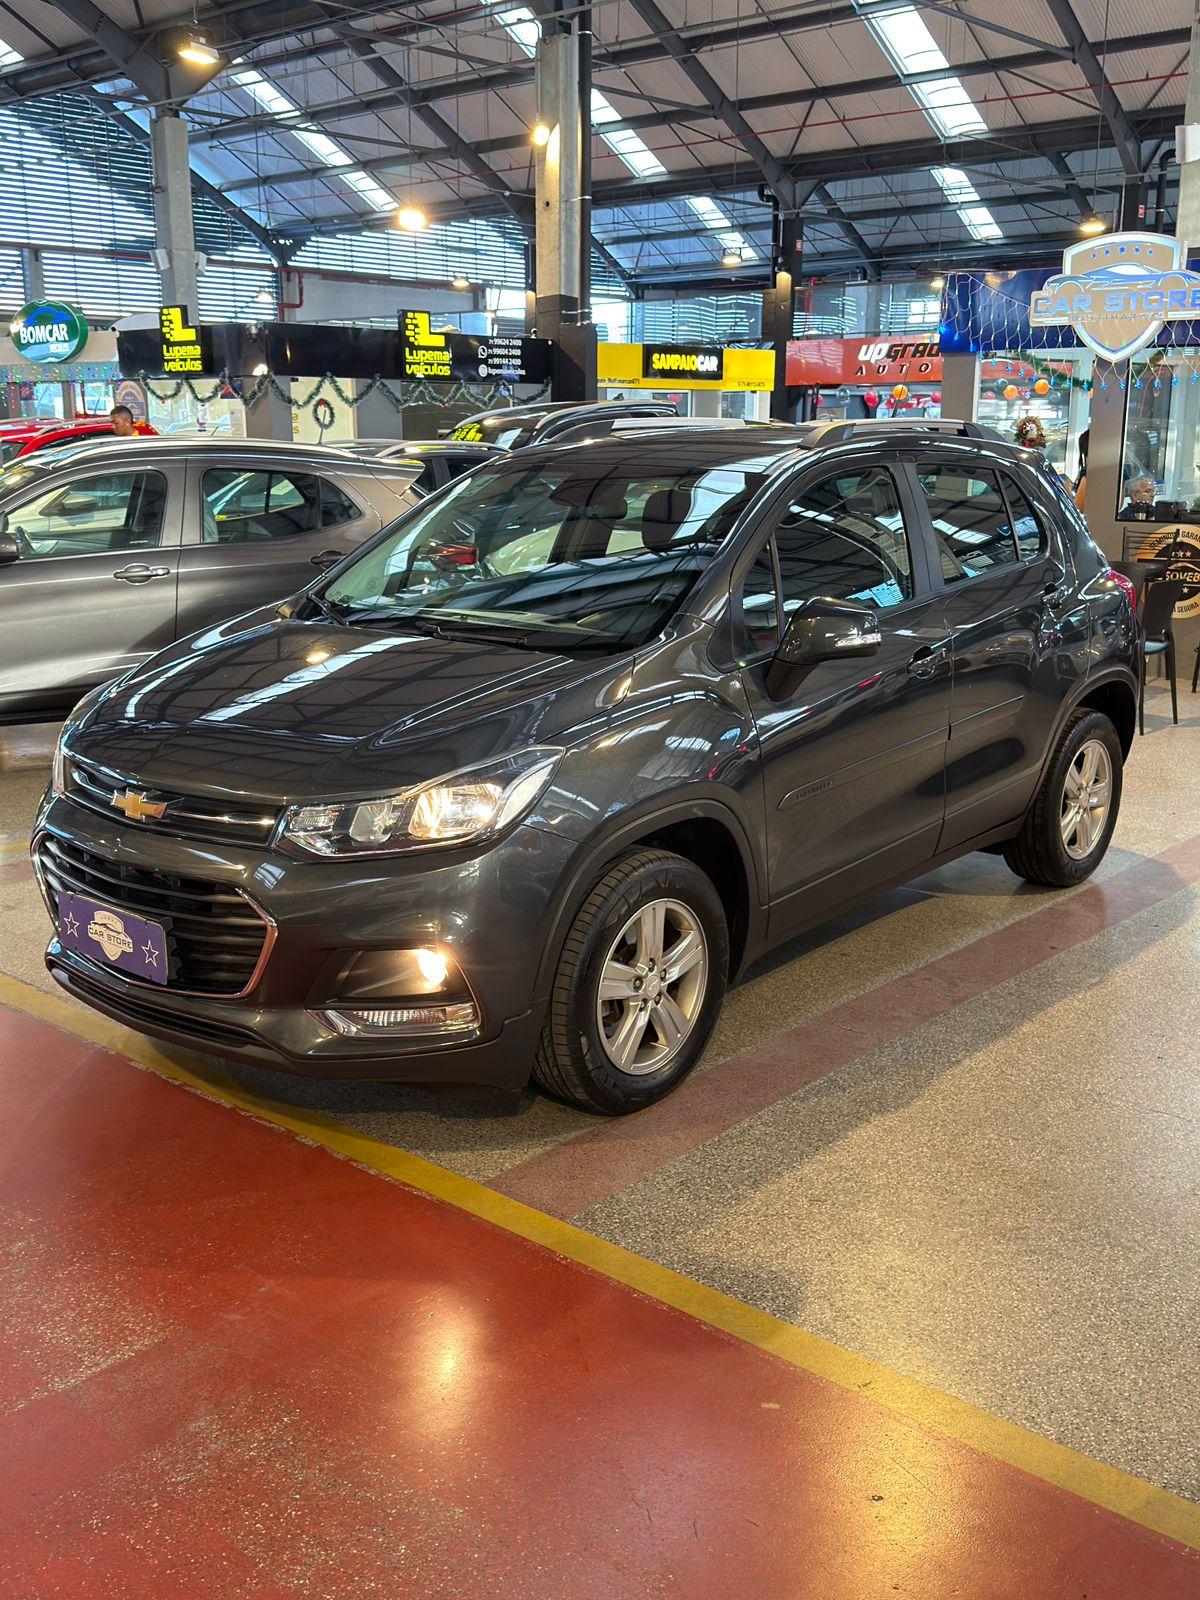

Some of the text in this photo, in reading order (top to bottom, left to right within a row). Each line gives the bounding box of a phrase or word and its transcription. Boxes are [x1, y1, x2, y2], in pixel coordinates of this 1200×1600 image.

[1033, 295, 1093, 315] CAR
[20, 323, 69, 344] BOMCAR
[162, 344, 202, 358] Lupema
[405, 347, 450, 363] Lupema
[164, 358, 203, 372] veículos
[405, 362, 451, 376] veículos
[89, 927, 104, 938] CAR
[107, 933, 132, 949] STORE
